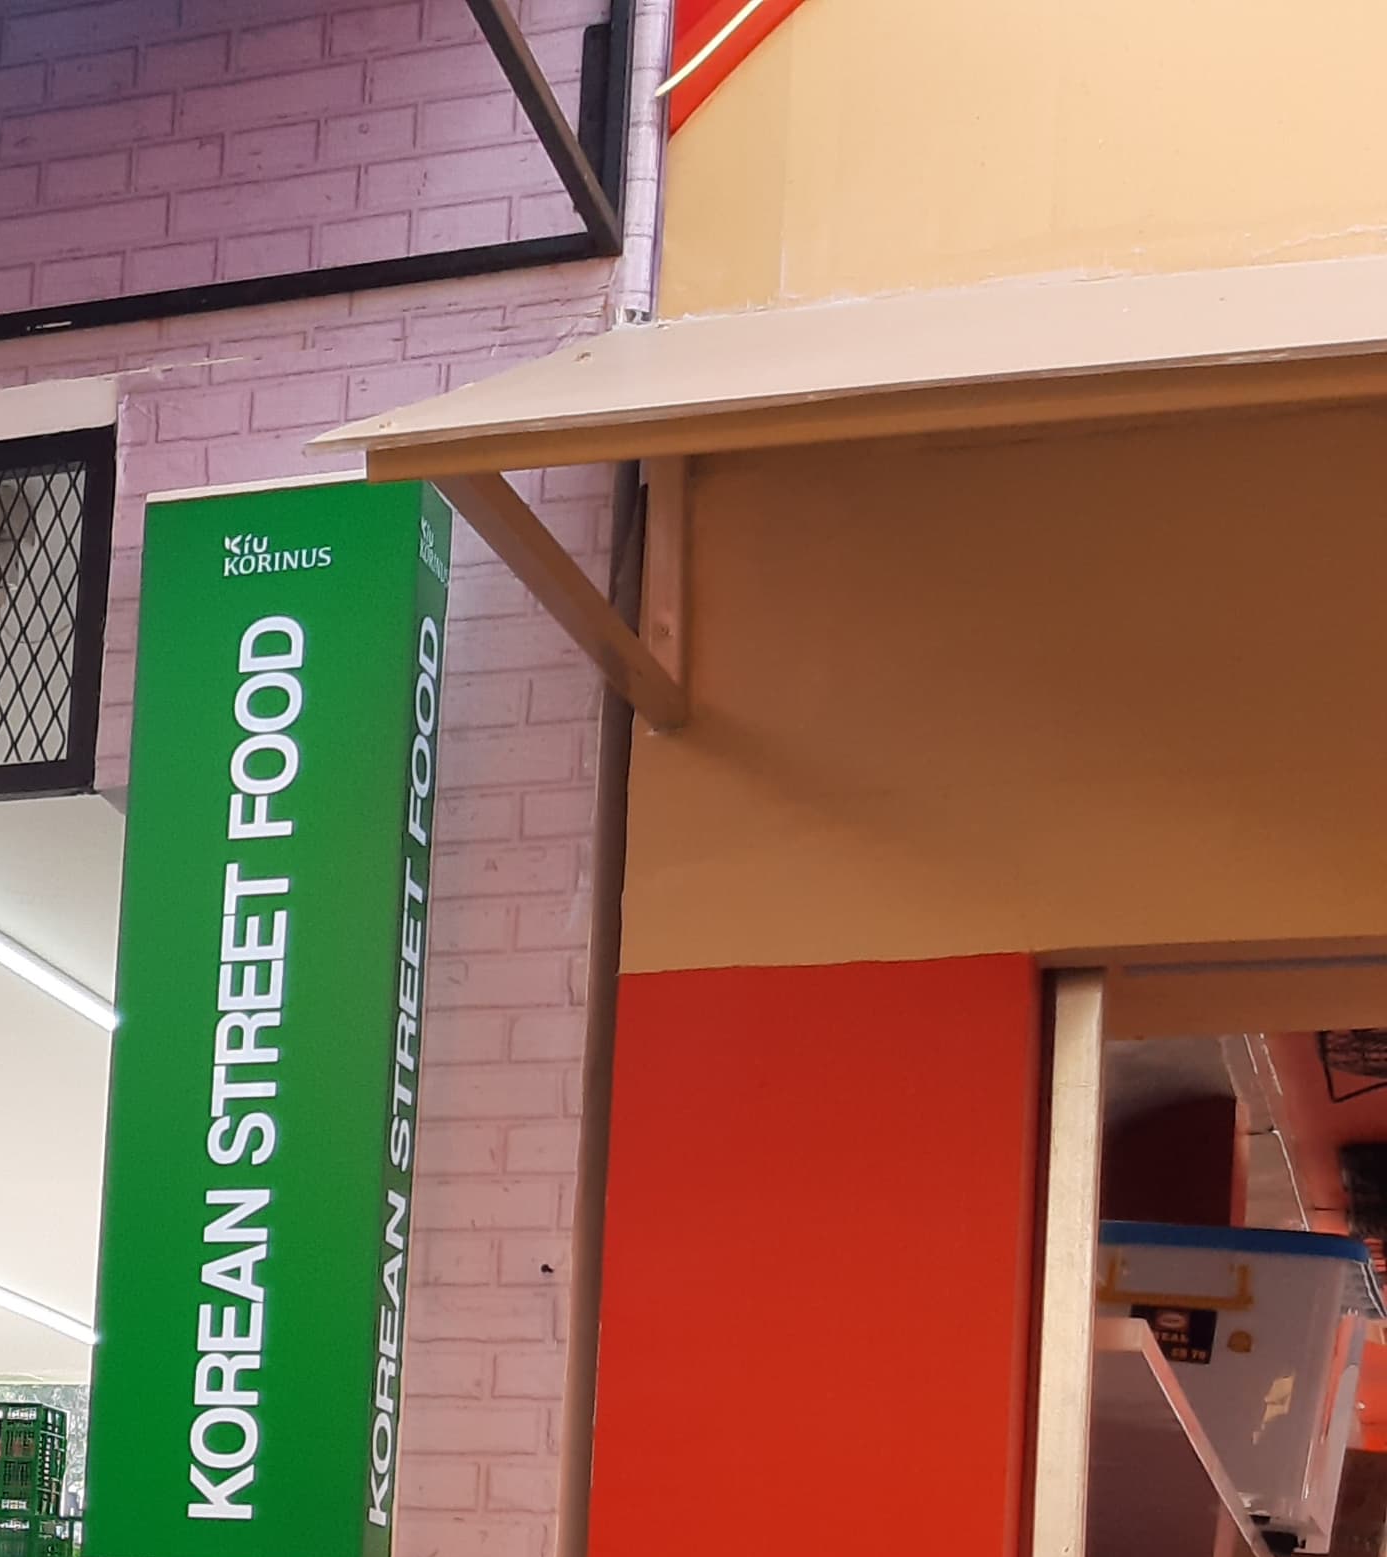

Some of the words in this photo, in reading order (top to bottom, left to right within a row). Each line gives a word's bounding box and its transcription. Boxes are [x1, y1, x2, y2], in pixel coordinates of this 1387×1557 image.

[223, 546, 332, 577] KORINUS
[228, 615, 306, 841] FOOD
[207, 861, 297, 1167] STREET
[368, 1193, 405, 1526] KOREAN
[390, 856, 423, 1167] STREET
[407, 615, 439, 847] FOOD
[188, 1188, 272, 1521] KOREAN
